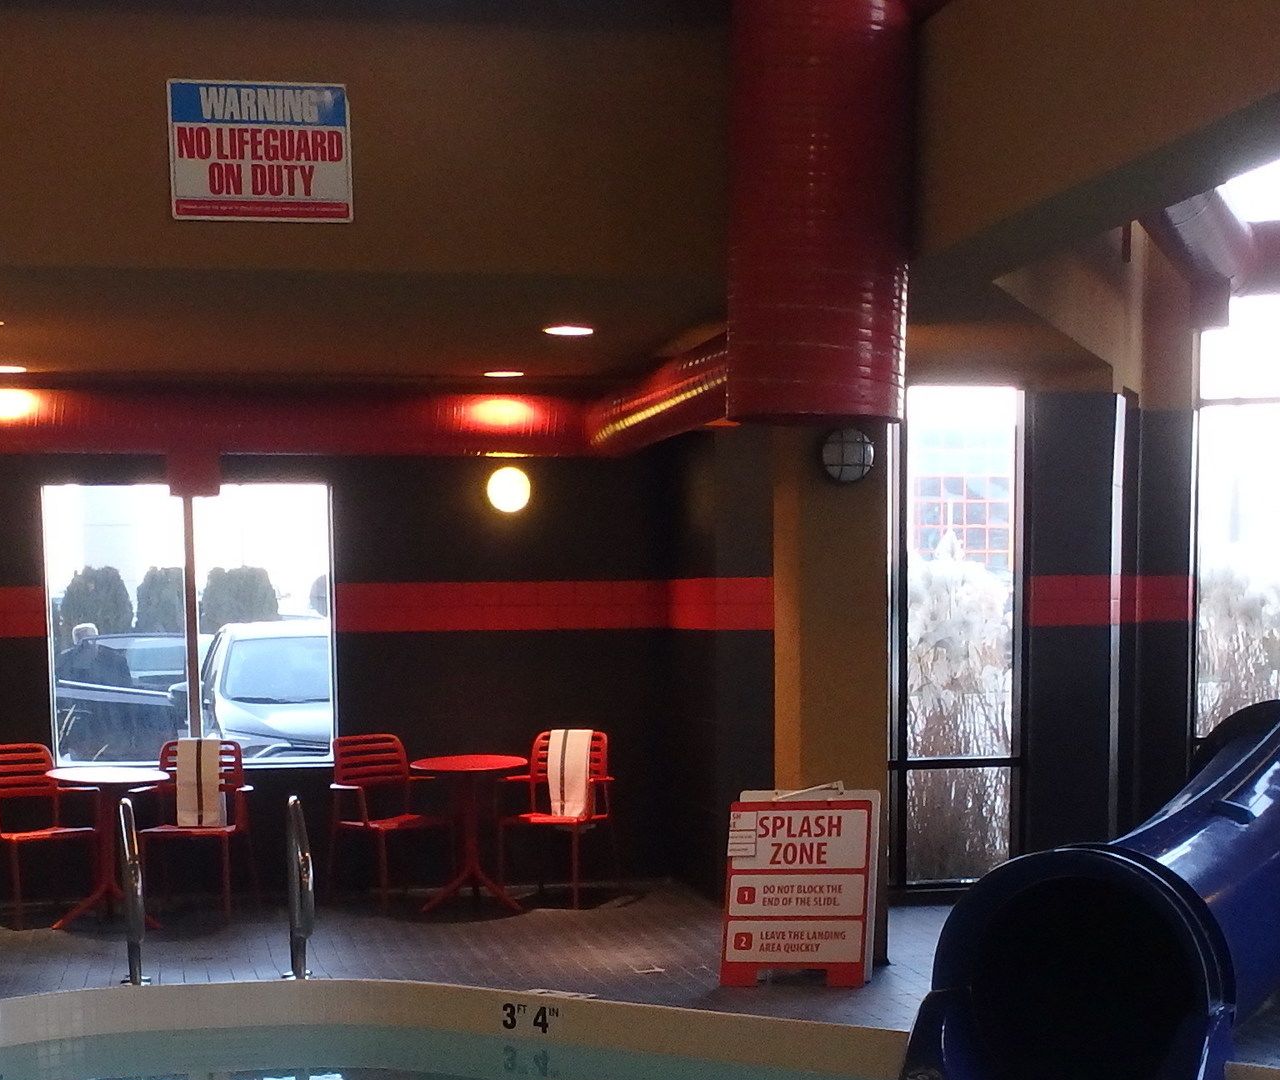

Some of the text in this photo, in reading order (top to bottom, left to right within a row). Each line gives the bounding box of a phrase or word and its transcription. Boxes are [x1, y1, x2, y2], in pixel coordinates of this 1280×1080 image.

[199, 86, 319, 122] WARNING
[177, 126, 343, 162] NO LIFEGUARD
[208, 162, 315, 197] ON DUTY
[757, 815, 842, 839] SPLASH
[769, 842, 828, 865] ZONE
[763, 884, 843, 895] DO NOT BLOCK THE
[743, 891, 750, 902] 1
[762, 897, 780, 907] END
[782, 897, 793, 906] OF
[795, 897, 811, 907] THE
[760, 930, 847, 941] LEAVE THE LANDING
[739, 937, 747, 948] 2
[759, 942, 821, 954] AREA QUICKLY
